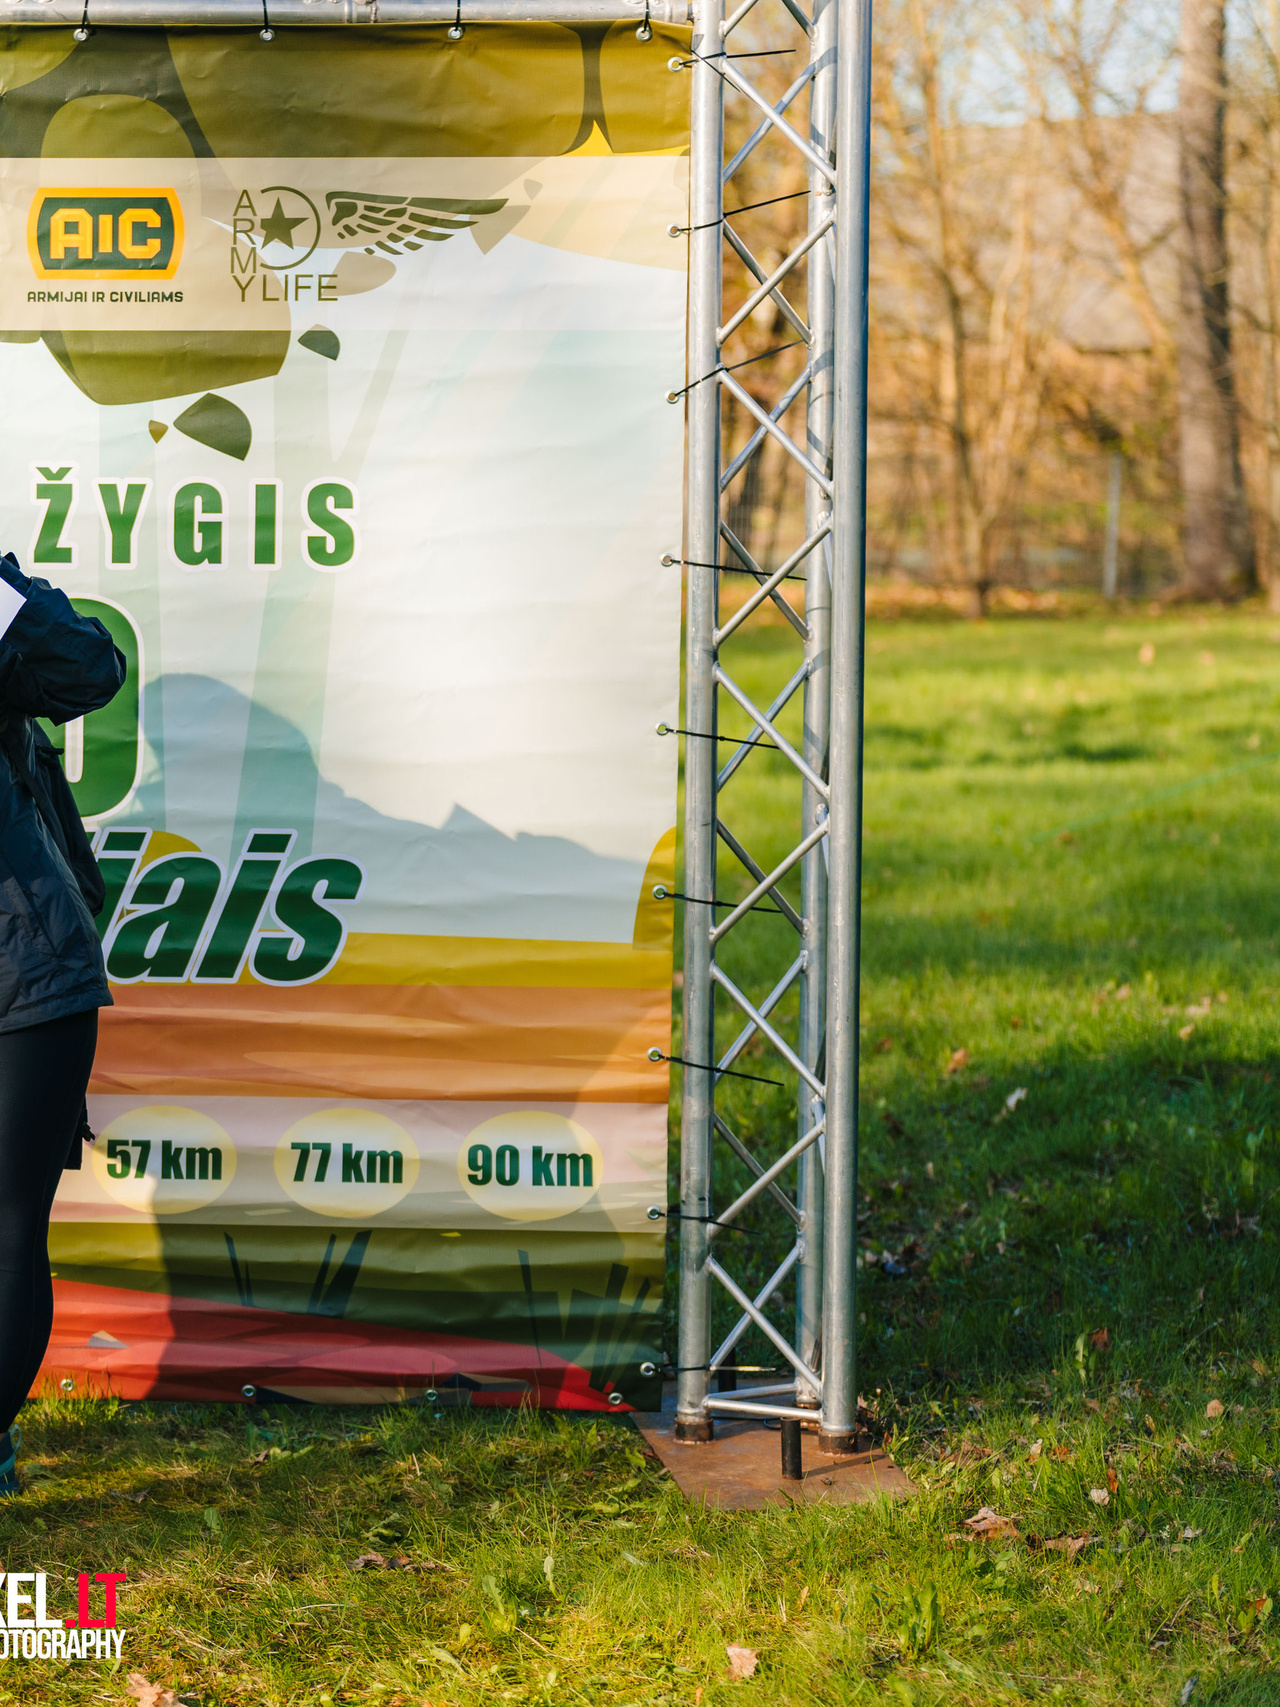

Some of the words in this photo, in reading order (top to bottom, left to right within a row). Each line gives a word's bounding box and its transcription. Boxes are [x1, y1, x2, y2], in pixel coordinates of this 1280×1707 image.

[27, 291, 87, 302] ARMIJAI
[92, 291, 105, 302] IR
[110, 291, 183, 302] CIVILIAMS
[33, 466, 354, 566] ŽYGIS
[107, 1139, 150, 1179] 57
[161, 1140, 222, 1181] km
[291, 1142, 332, 1182] 77
[342, 1143, 403, 1184] km
[468, 1145, 521, 1187] 90
[532, 1146, 593, 1188] km
